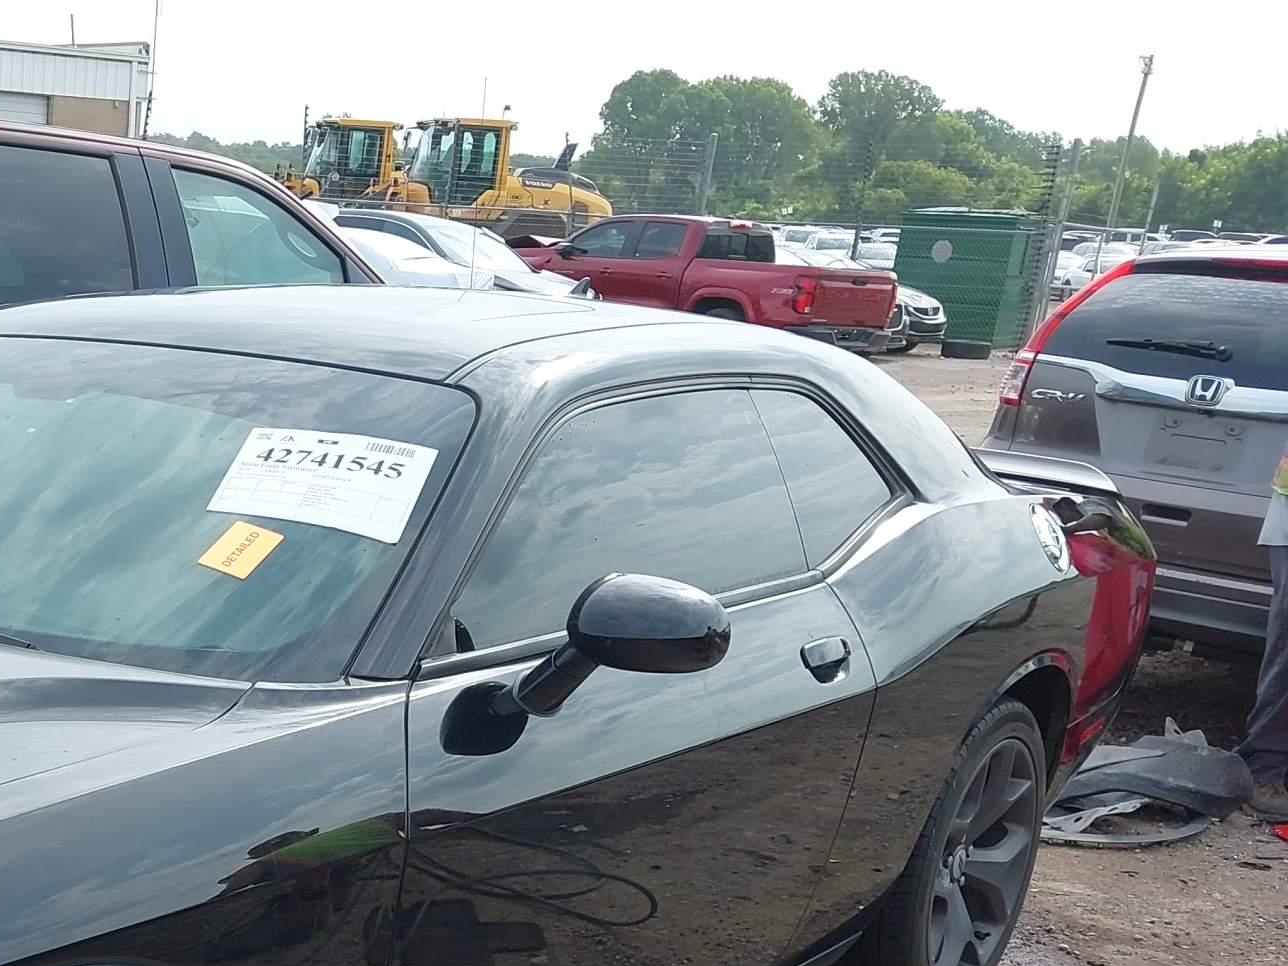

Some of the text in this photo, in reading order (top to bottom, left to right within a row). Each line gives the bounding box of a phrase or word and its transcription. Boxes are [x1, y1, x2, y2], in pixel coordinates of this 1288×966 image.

[524, 180, 553, 188] VOLVO
[256, 447, 406, 479] 42741545
[221, 531, 261, 568] DETAILED
